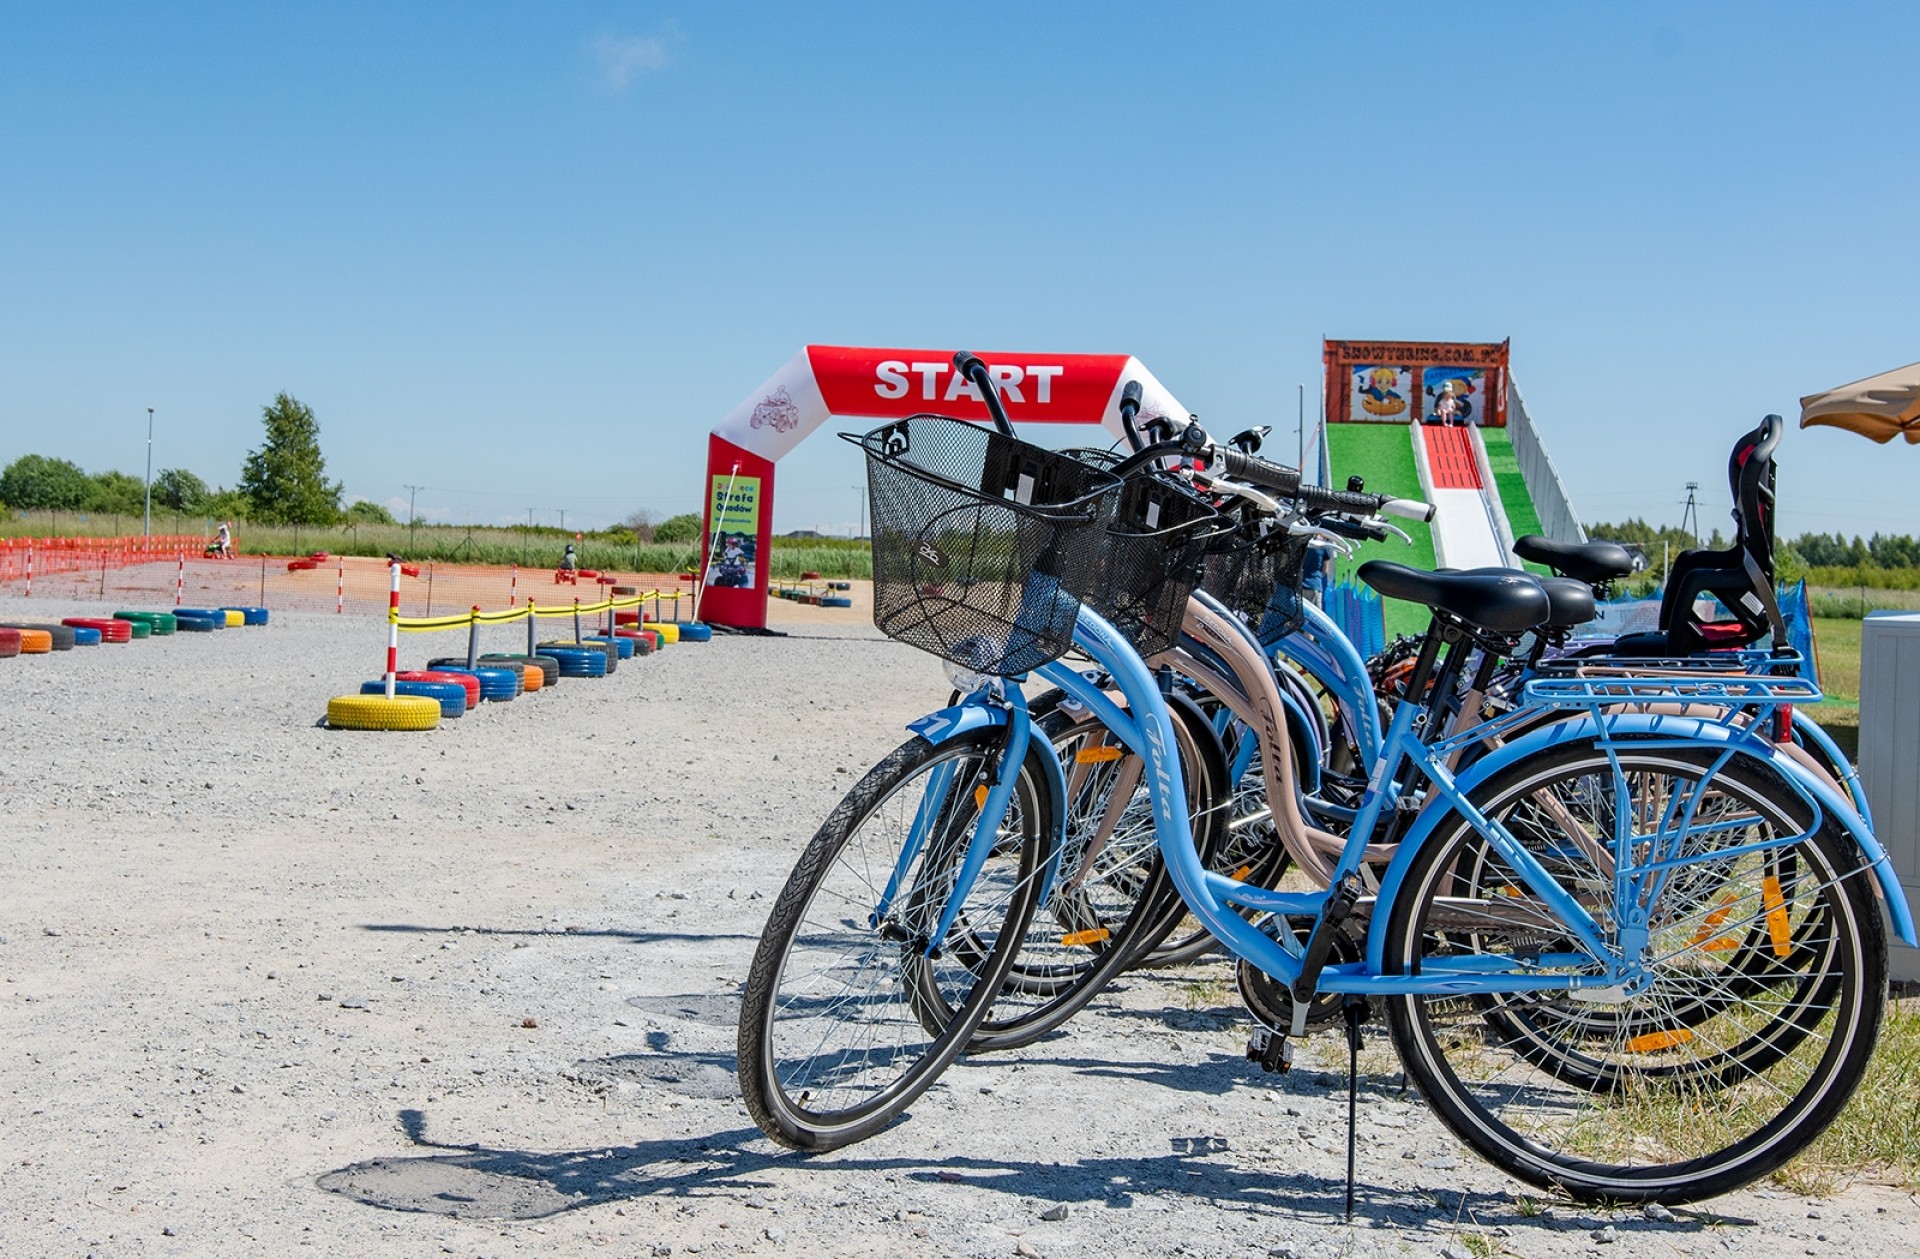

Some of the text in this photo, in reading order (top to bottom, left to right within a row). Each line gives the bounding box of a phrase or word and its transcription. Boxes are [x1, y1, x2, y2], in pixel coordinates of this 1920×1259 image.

[874, 360, 1063, 404] START
[1145, 713, 1172, 821] Folta
[1258, 696, 1283, 784] Folta
